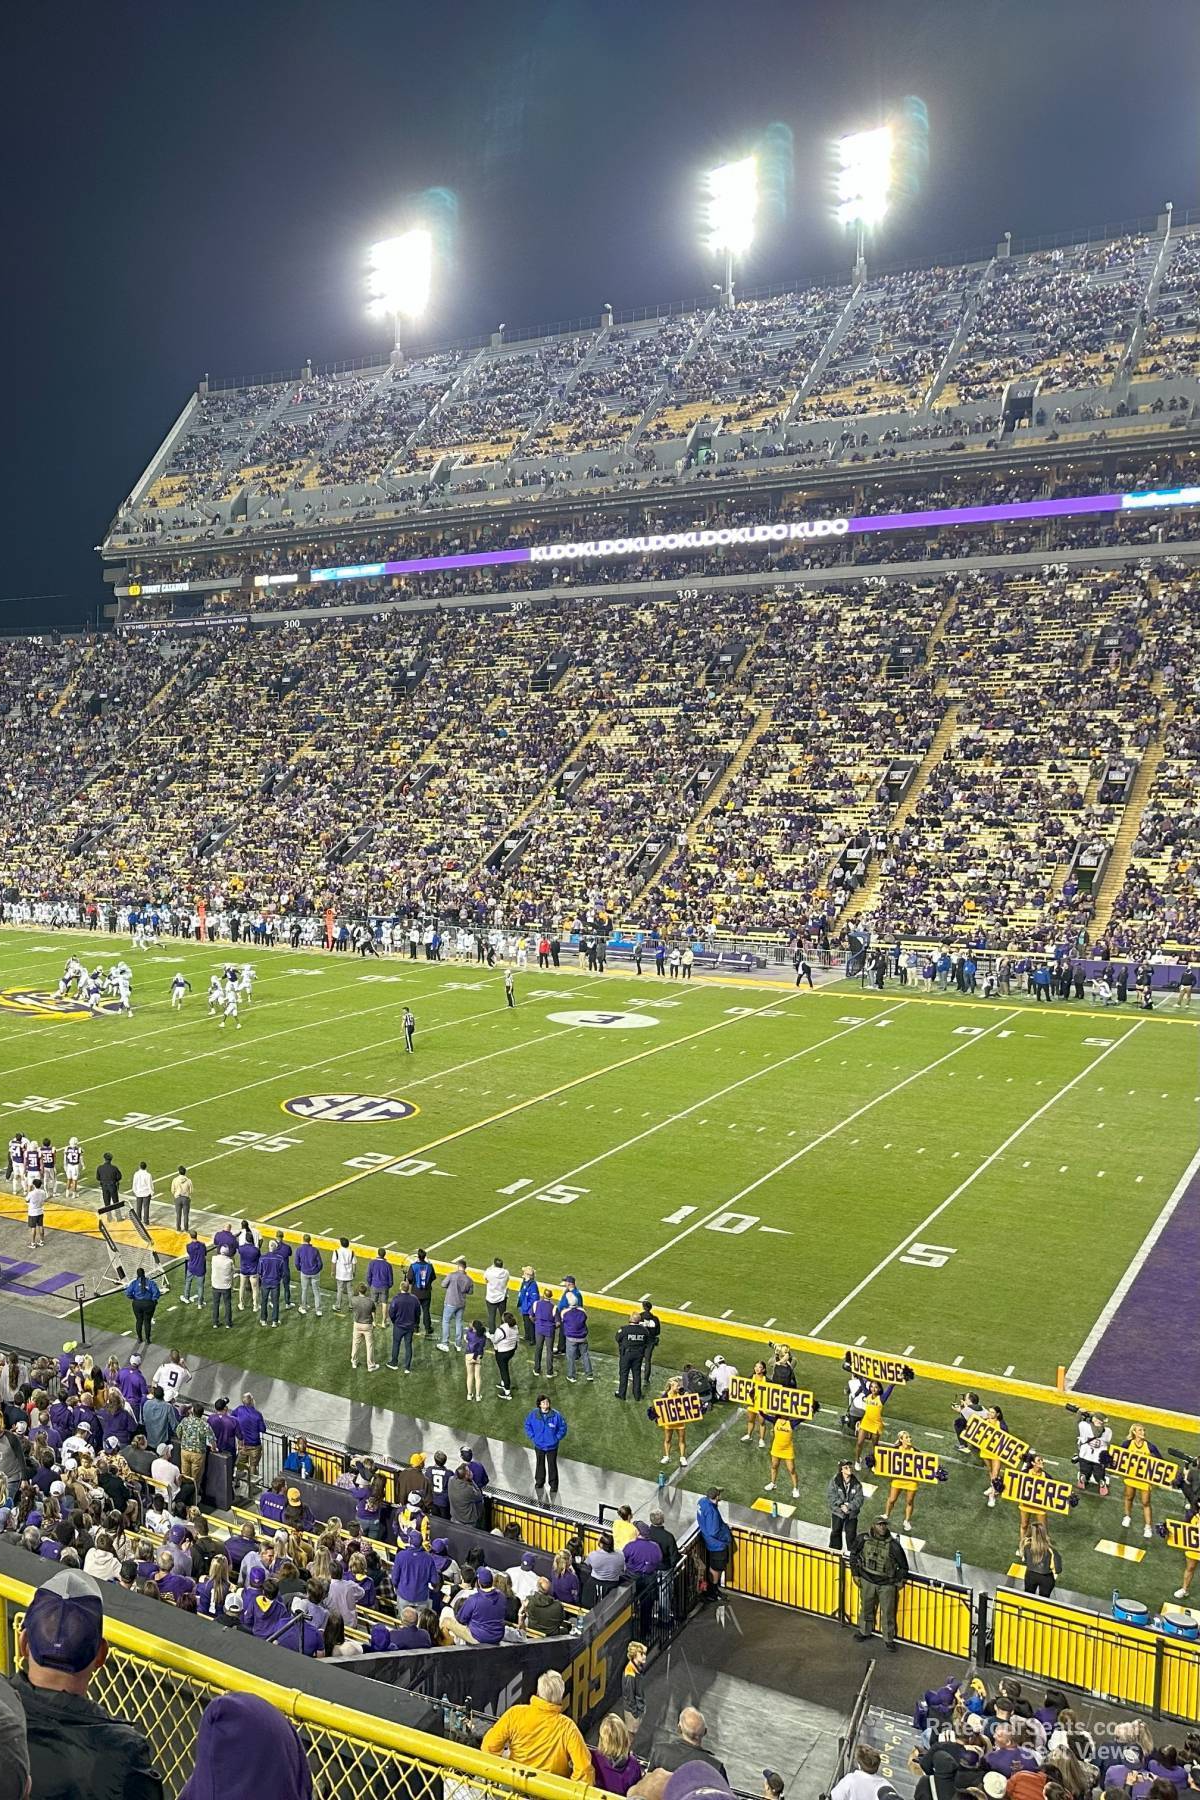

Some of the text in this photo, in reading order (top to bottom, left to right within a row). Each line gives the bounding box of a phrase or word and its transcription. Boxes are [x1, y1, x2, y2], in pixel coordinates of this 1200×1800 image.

[789, 517, 850, 540] KUDO
[1040, 563, 1069, 576] 305
[676, 589, 699, 600] 303
[284, 619, 301, 629] 300
[380, 612, 393, 622] 30
[27, 636, 43, 646] 242
[622, 997, 684, 1008] 25
[722, 1006, 787, 1018] 20
[1081, 1037, 1115, 1047] 5
[1, 1096, 80, 1113] 35
[290, 1093, 408, 1122] SEC
[103, 1112, 184, 1132] 30
[216, 1131, 304, 1153] 25
[29, 1157, 38, 1167] 31
[67, 1153, 79, 1163] 43
[341, 1152, 438, 1177] 20
[496, 1178, 591, 1205] 15
[660, 1205, 761, 1235] 10
[898, 1242, 959, 1269] 5
[627, 1333, 645, 1342] POLICE
[852, 1352, 904, 1383] DEFENSE
[167, 1371, 179, 1388] 9
[655, 1394, 701, 1423] TIGERS
[758, 1385, 811, 1417] TIGERS
[965, 1416, 1025, 1467] DEFENSE
[877, 1448, 936, 1481] TIGERS
[1111, 1451, 1175, 1488] DEFENSE
[432, 1476, 444, 1493] 9
[1008, 1471, 1070, 1511] TIGERS
[1170, 1524, 1200, 1546] TIG
